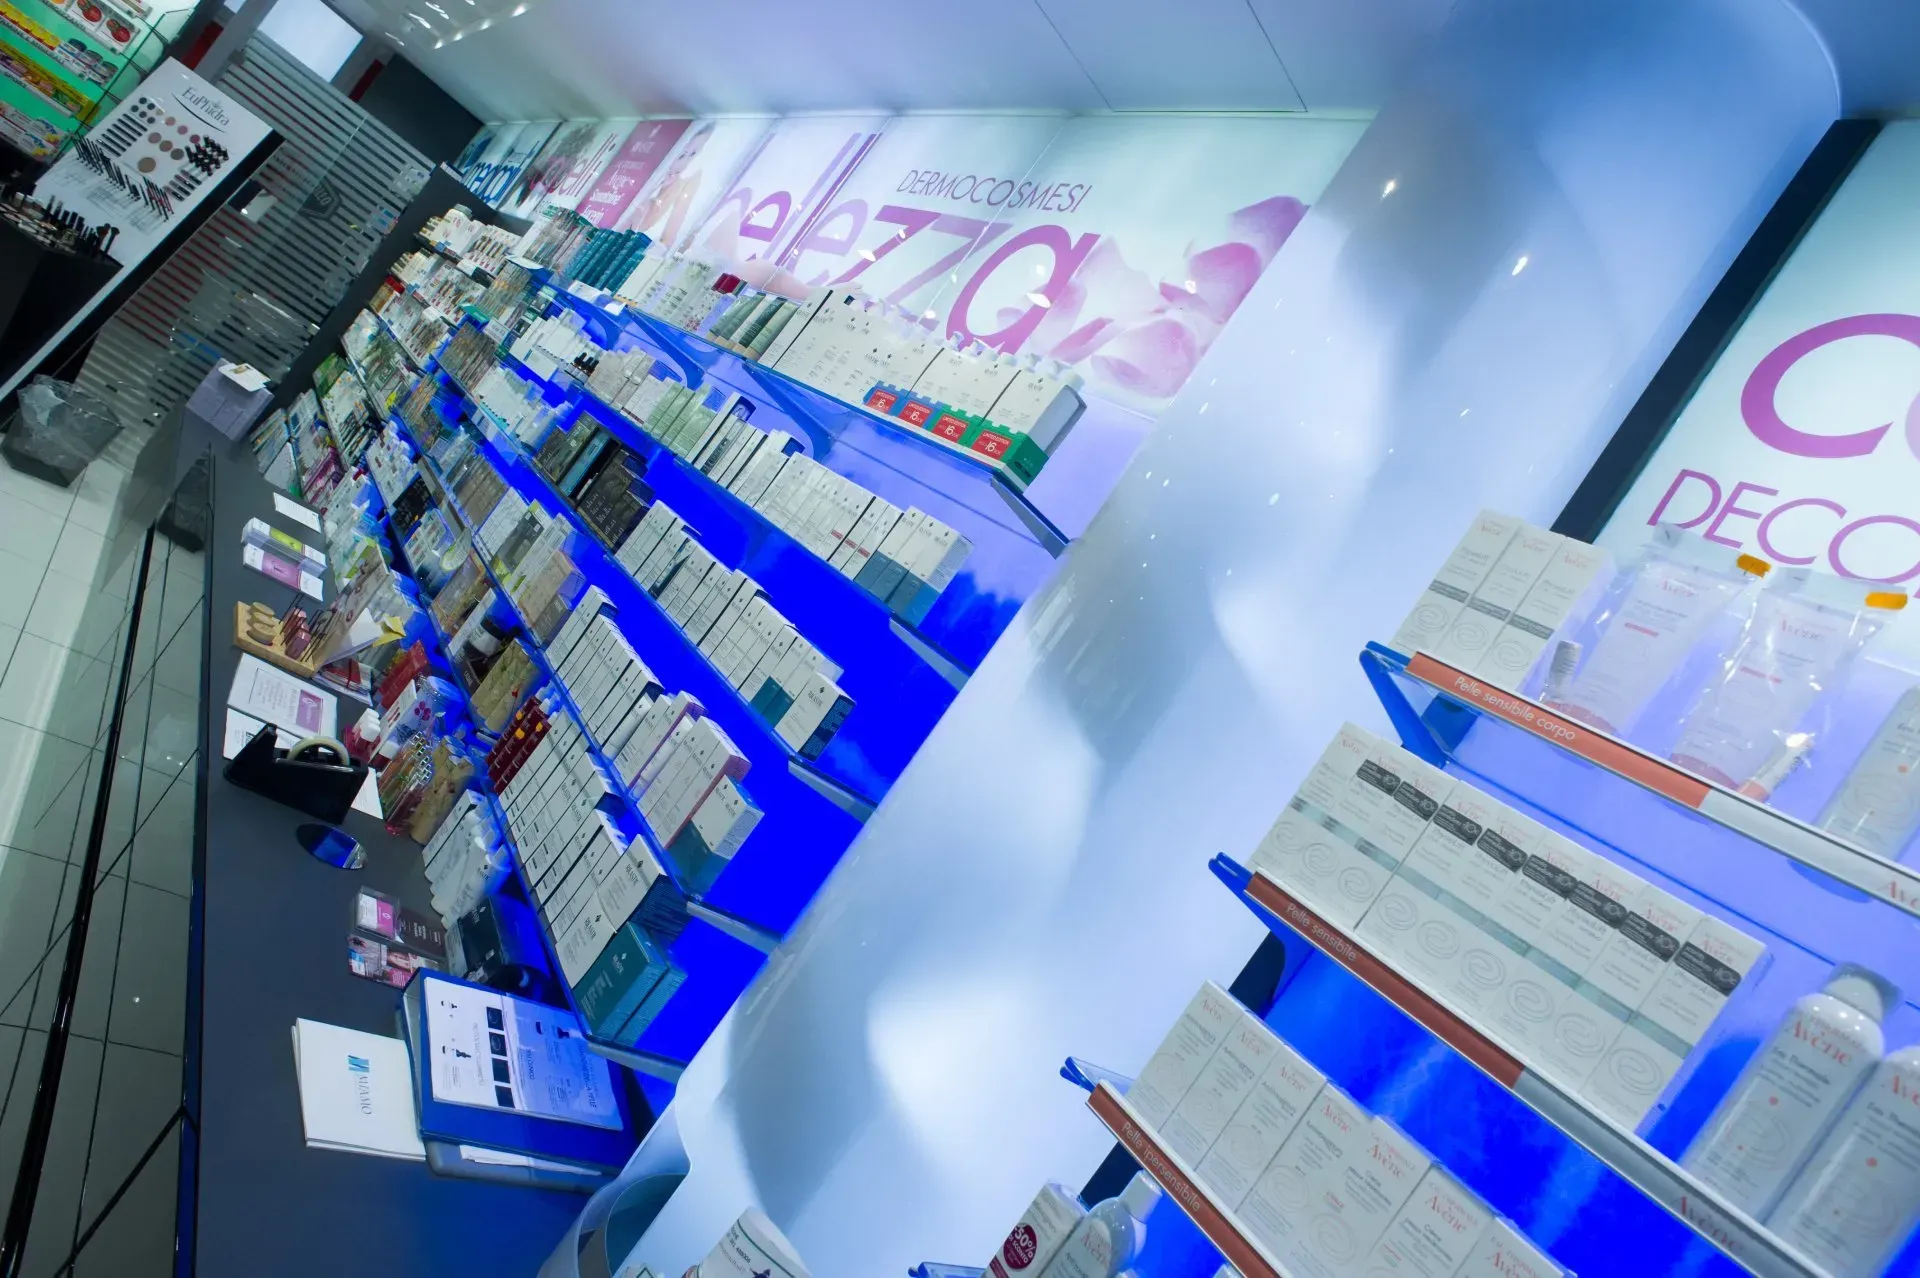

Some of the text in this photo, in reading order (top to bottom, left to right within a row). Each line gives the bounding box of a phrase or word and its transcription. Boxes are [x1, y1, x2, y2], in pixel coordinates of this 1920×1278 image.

[896, 169, 1093, 213] DERMOCOSMESI
[1454, 675, 1576, 742] Pelle sensibile corpo
[1285, 903, 1357, 961] Pelle sensibile
[358, 1075, 373, 1115] MIAMO
[1121, 1121, 1201, 1213] Pelle ipersensibile
